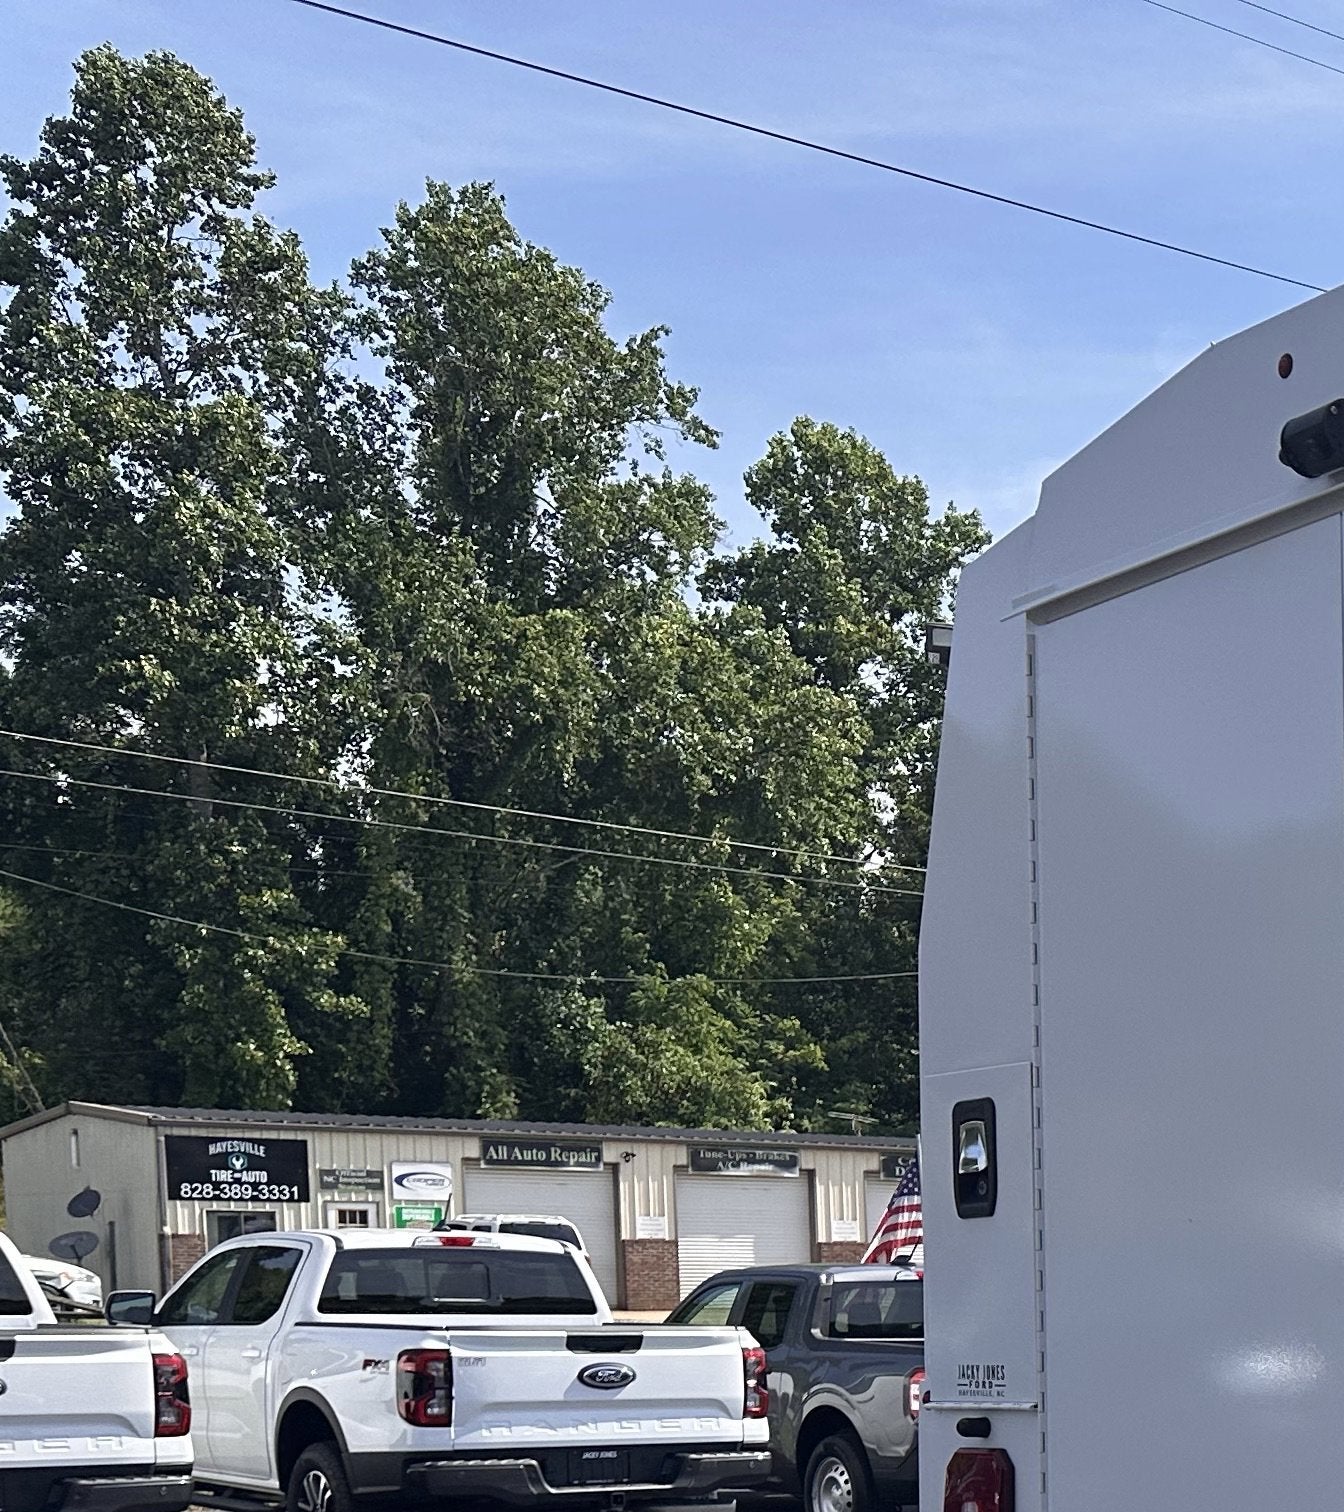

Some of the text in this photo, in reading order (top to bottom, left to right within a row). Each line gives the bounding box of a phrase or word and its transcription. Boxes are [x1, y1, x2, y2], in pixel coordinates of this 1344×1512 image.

[208, 1141, 266, 1157] HAYESVILLE
[486, 1145, 599, 1165] All Auto Repair
[180, 1182, 299, 1200] 828-389-3331
[958, 1364, 1005, 1381] JACKY JONES
[969, 1381, 994, 1390] FORD
